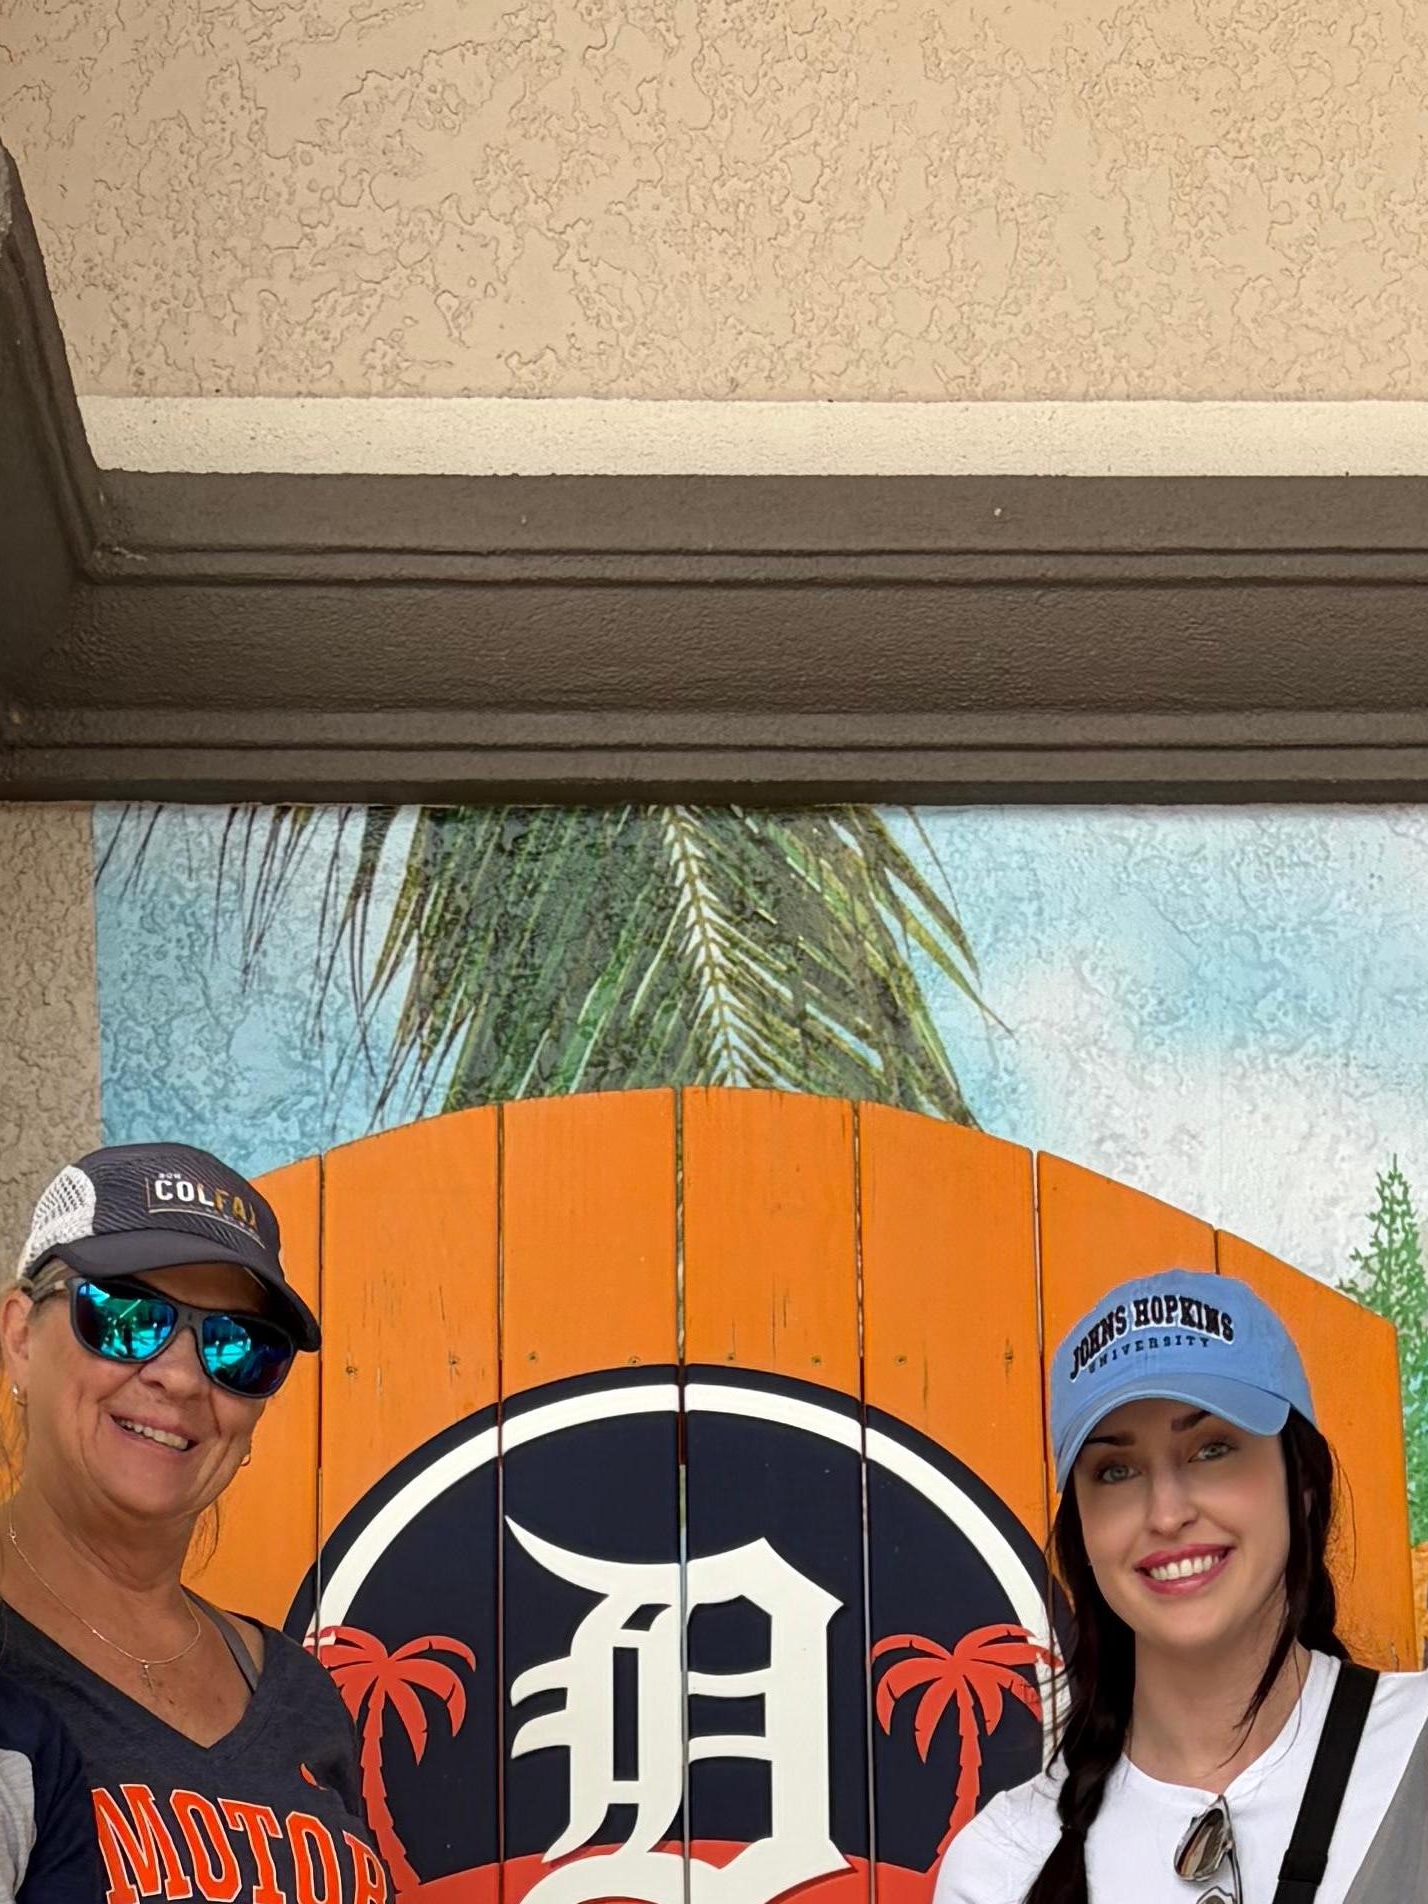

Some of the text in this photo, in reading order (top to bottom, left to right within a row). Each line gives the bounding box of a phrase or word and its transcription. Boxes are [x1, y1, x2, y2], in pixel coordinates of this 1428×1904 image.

[1070, 1294, 1236, 1384] JOHNS HOPKINS
[1088, 1334, 1211, 1374] UNIVERSITY
